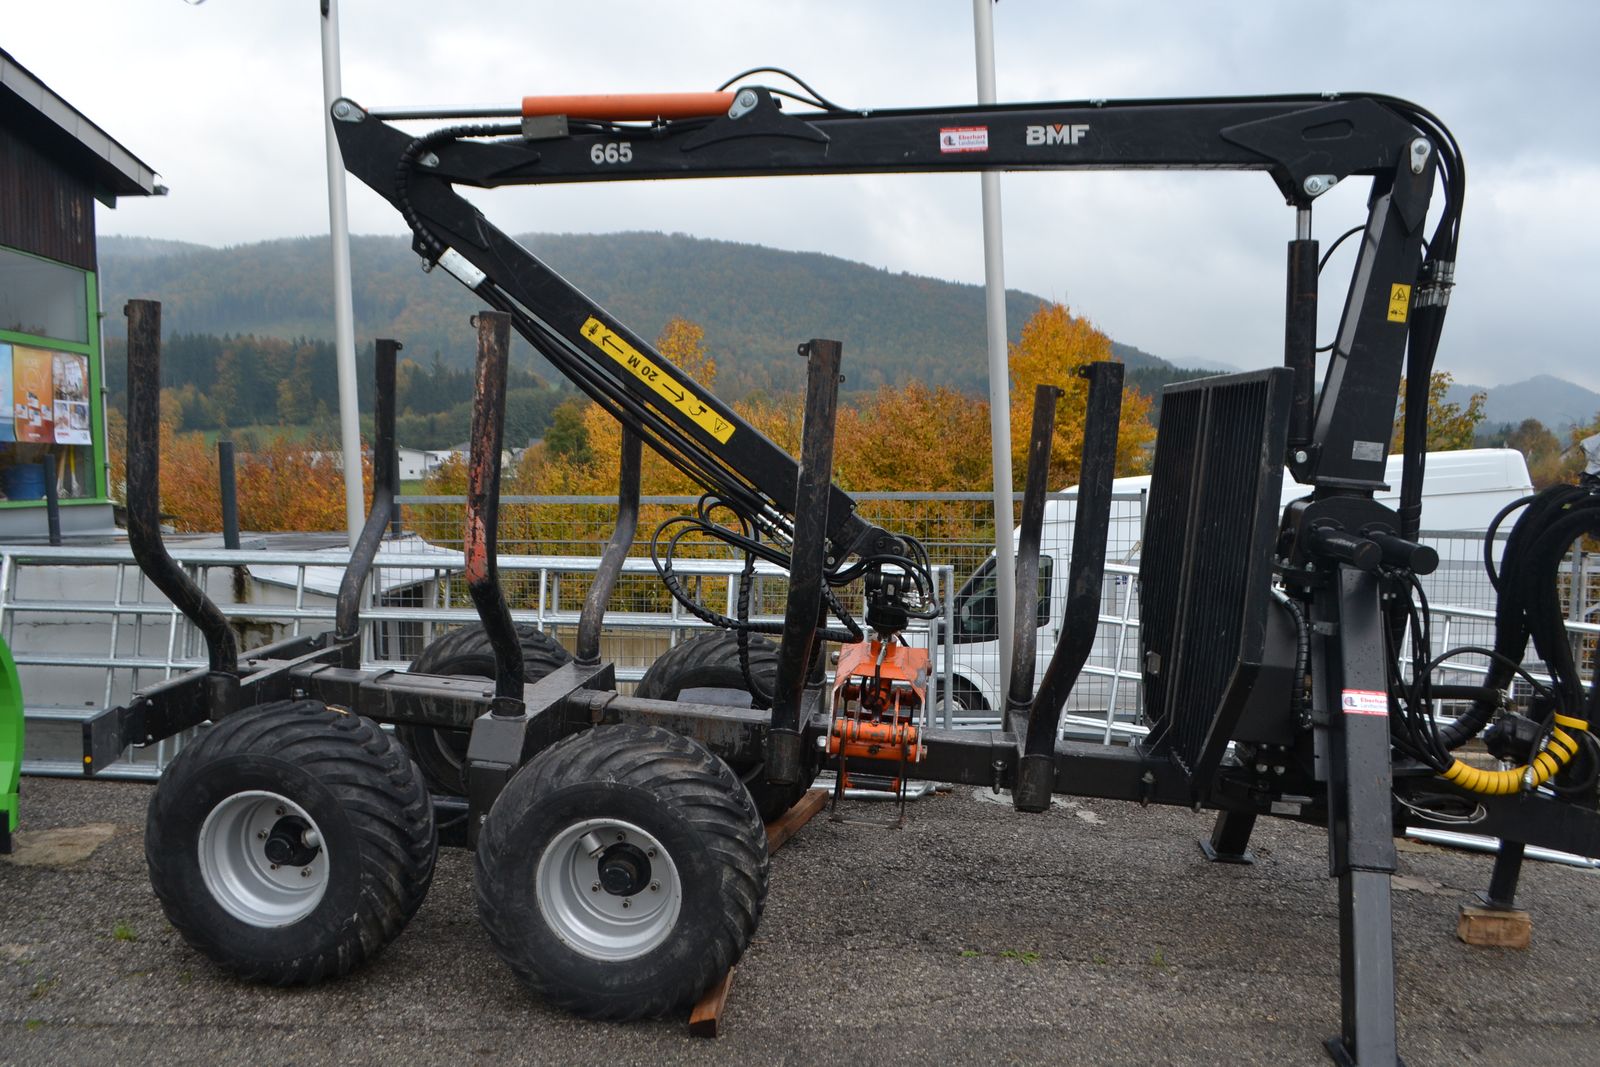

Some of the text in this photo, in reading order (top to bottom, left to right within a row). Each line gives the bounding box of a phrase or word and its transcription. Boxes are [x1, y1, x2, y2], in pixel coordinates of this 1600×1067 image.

[1026, 124, 1090, 145] BMF
[590, 142, 633, 164] 665
[627, 354, 659, 382] 20 M
